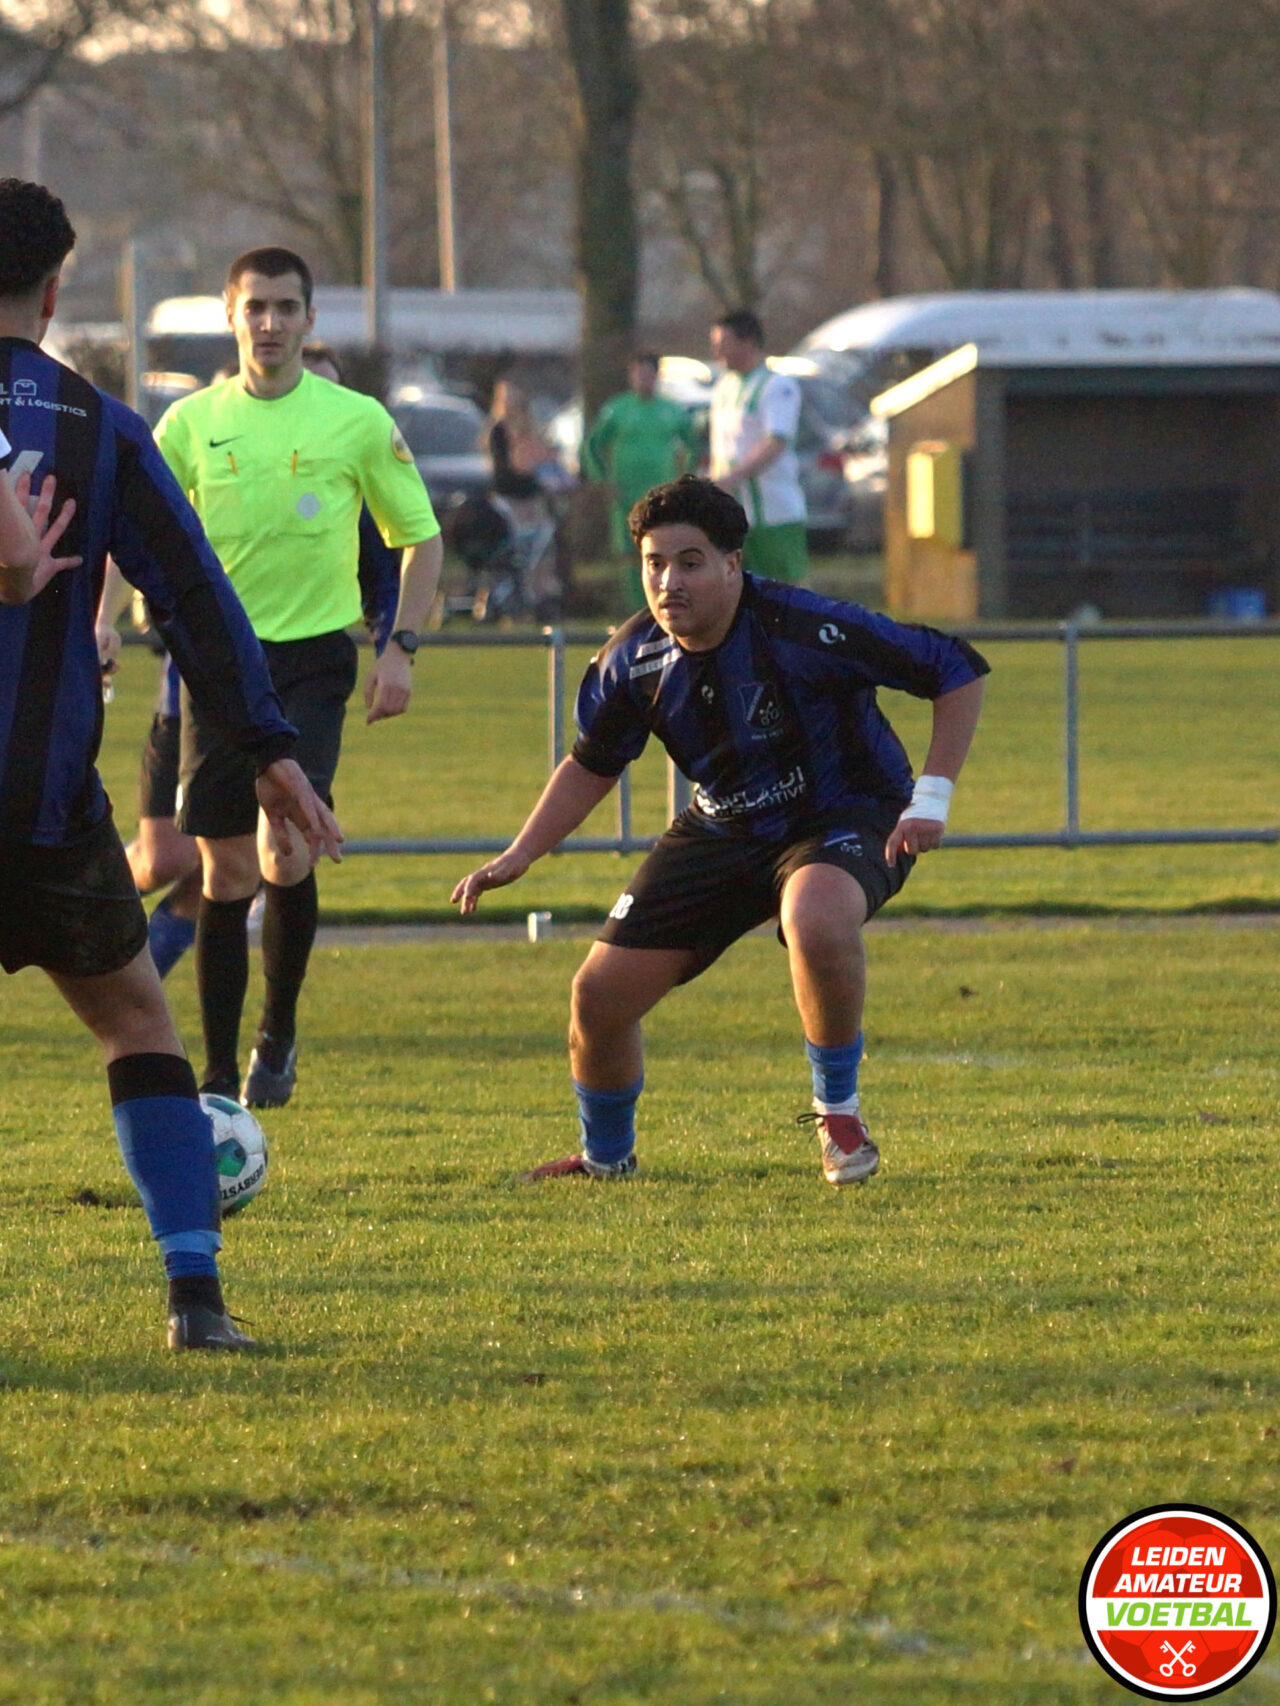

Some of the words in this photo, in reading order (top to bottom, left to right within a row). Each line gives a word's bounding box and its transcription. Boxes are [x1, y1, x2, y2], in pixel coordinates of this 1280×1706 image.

[15, 396, 25, 407] &
[28, 398, 87, 417] LOGISTICS
[220, 1163, 264, 1201] DERBYST
